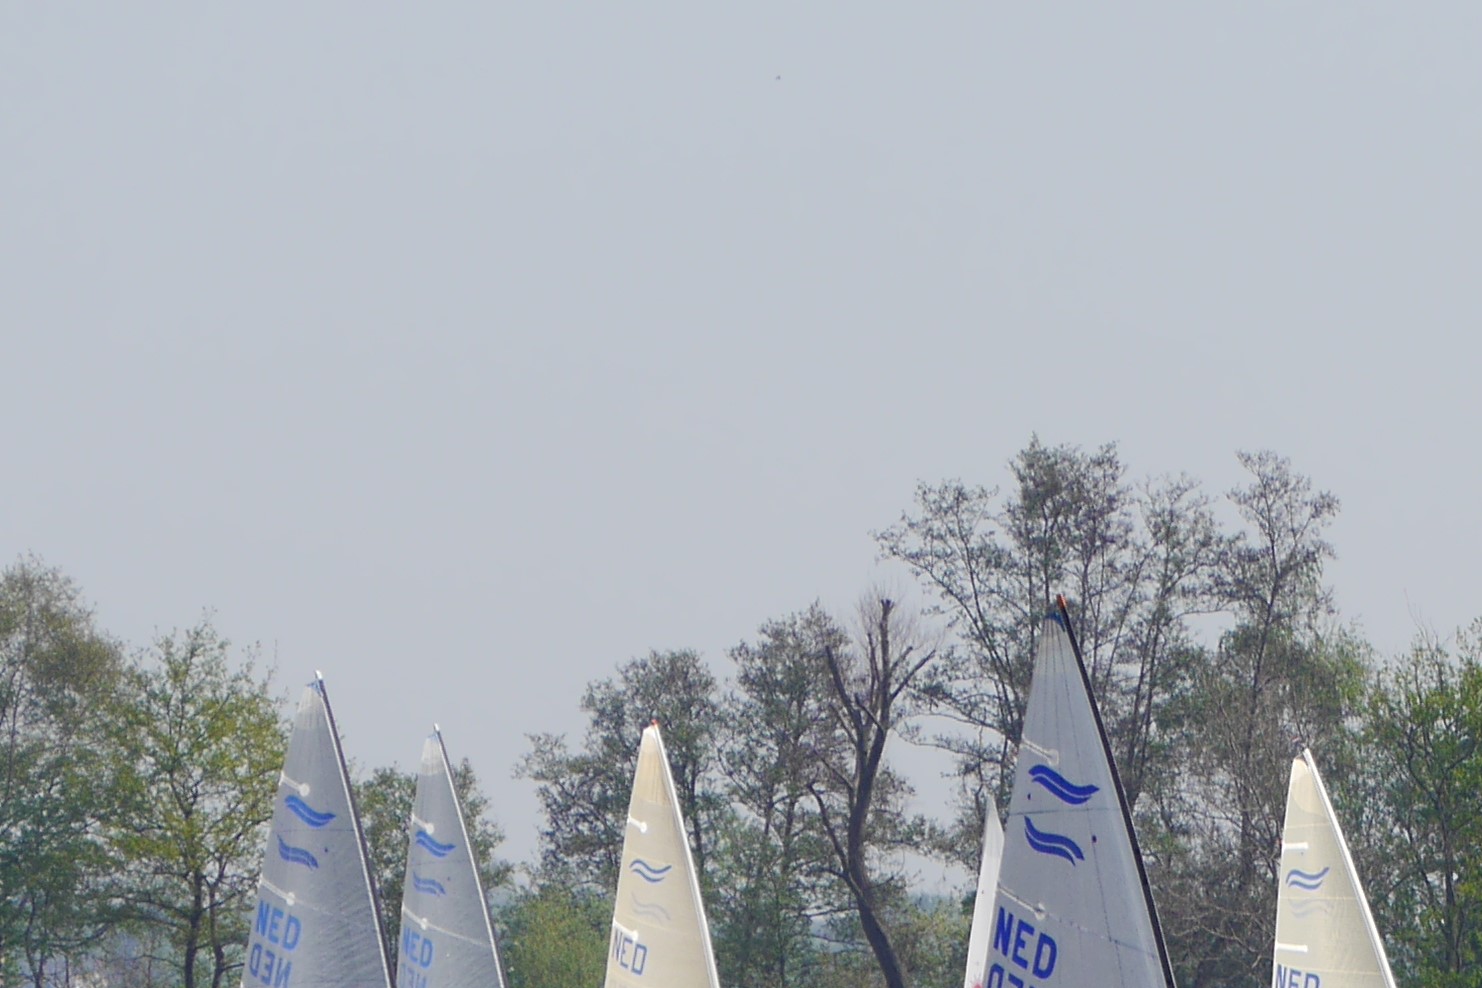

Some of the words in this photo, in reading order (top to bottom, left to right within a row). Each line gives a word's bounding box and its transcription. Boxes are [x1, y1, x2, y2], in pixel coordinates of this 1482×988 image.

[256, 900, 301, 951] NED
[404, 926, 433, 969] NED
[993, 906, 1057, 980] NED
[612, 929, 647, 976] NED
